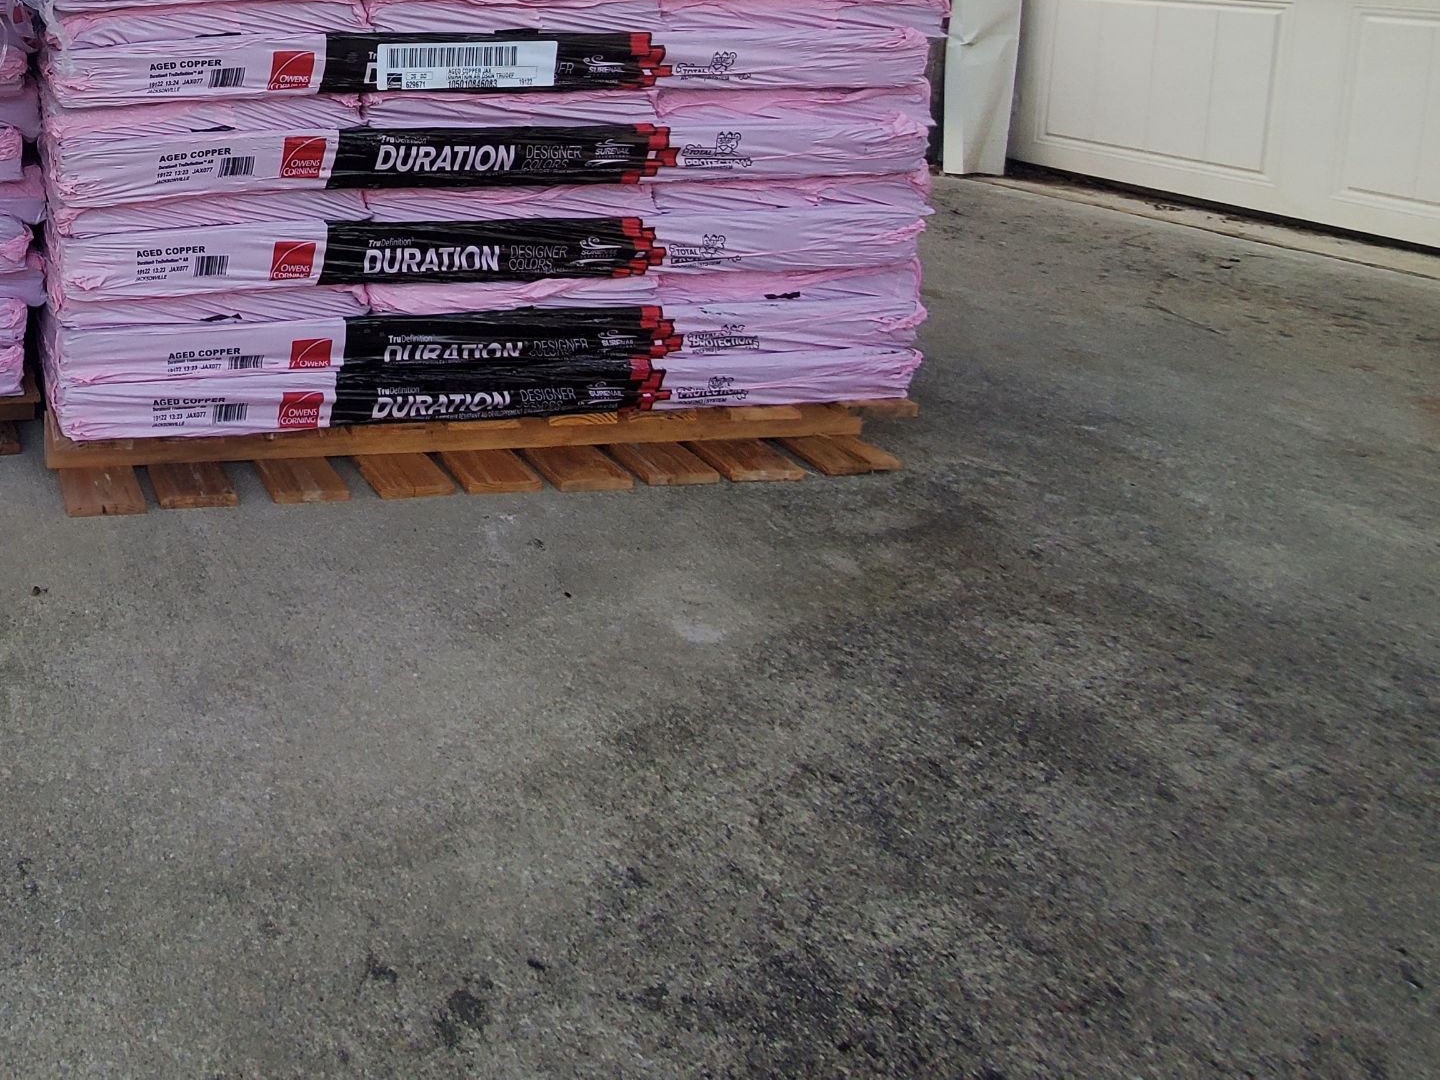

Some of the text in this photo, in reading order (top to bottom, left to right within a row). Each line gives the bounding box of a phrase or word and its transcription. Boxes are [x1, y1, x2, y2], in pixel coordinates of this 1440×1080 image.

[150, 59, 222, 71] AGED COPPER
[279, 75, 309, 83] OWENS
[159, 148, 231, 163] AGED COPPER
[375, 145, 516, 171] DURATION
[526, 146, 582, 159] DESIGNER
[291, 159, 320, 167] OWENS
[283, 167, 318, 176] CORNING
[136, 245, 205, 258] AGED COPPER
[510, 245, 568, 259] DESIGNER
[676, 248, 698, 256] TOTAL
[364, 245, 499, 274] DURATION
[509, 259, 552, 270] COLORS
[280, 264, 309, 272] OWENS
[168, 348, 240, 360] AGED COPPER
[520, 388, 577, 402] DESIGNER
[153, 398, 180, 406] AGED
[371, 391, 511, 419] DURATION
[289, 408, 317, 417] OWENS
[281, 416, 316, 424] CORNING
